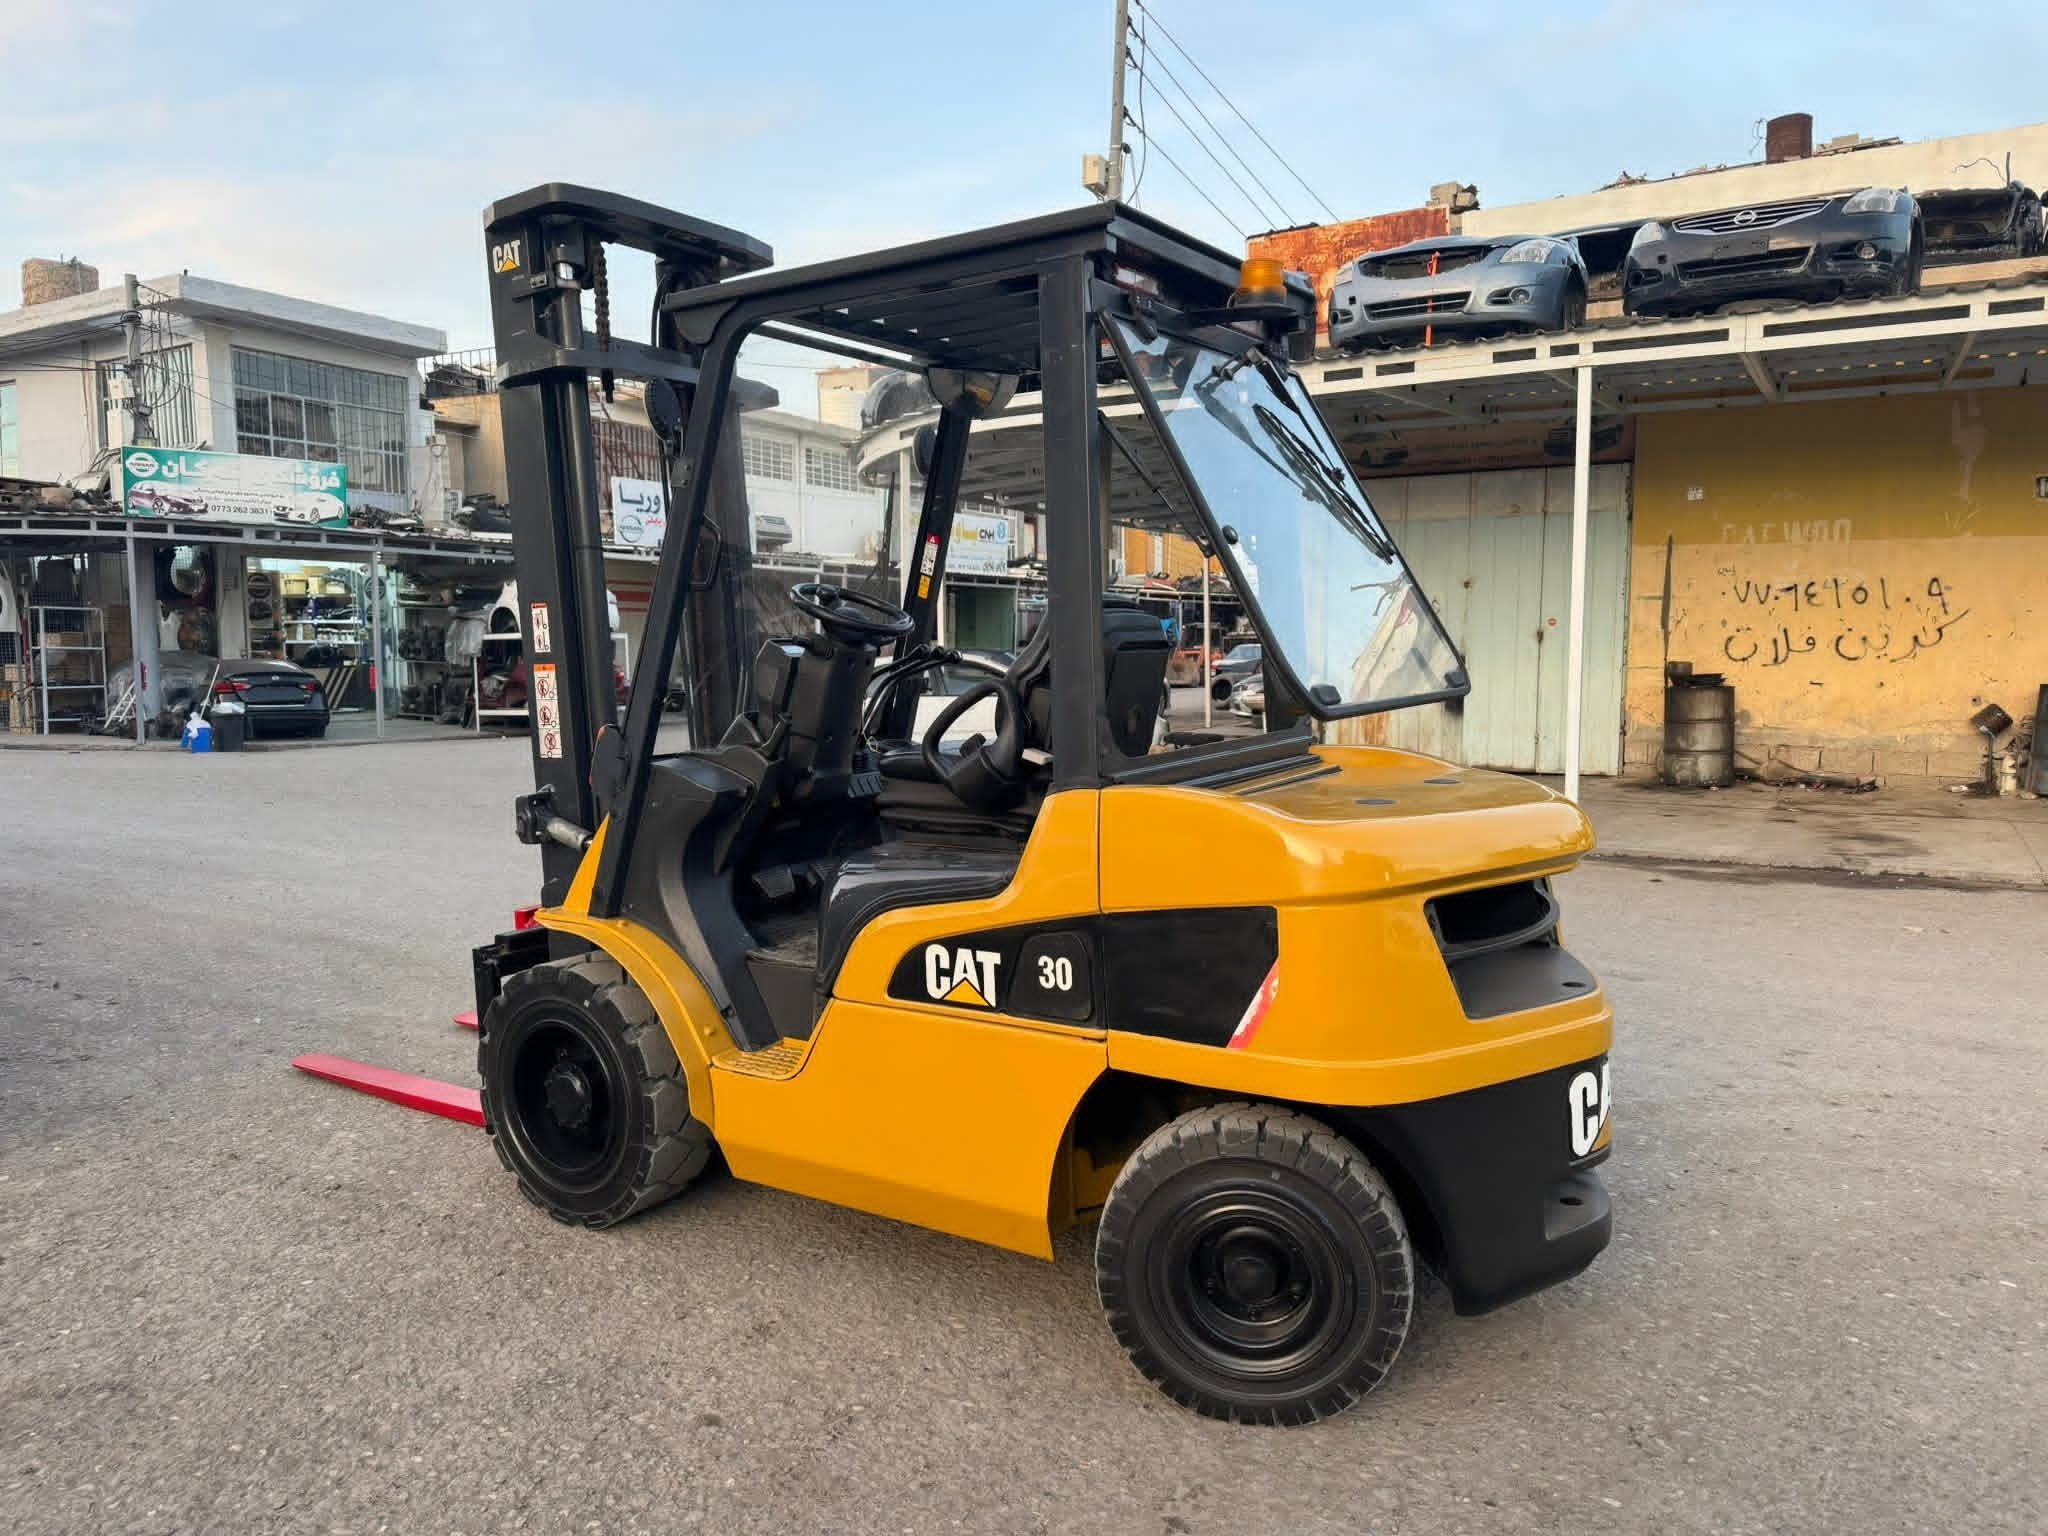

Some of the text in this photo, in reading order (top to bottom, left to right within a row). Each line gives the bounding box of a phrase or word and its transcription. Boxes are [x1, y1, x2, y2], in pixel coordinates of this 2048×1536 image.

[493, 240, 520, 273] CAT
[925, 944, 1001, 1008] CAT
[1038, 956, 1072, 991] 30
